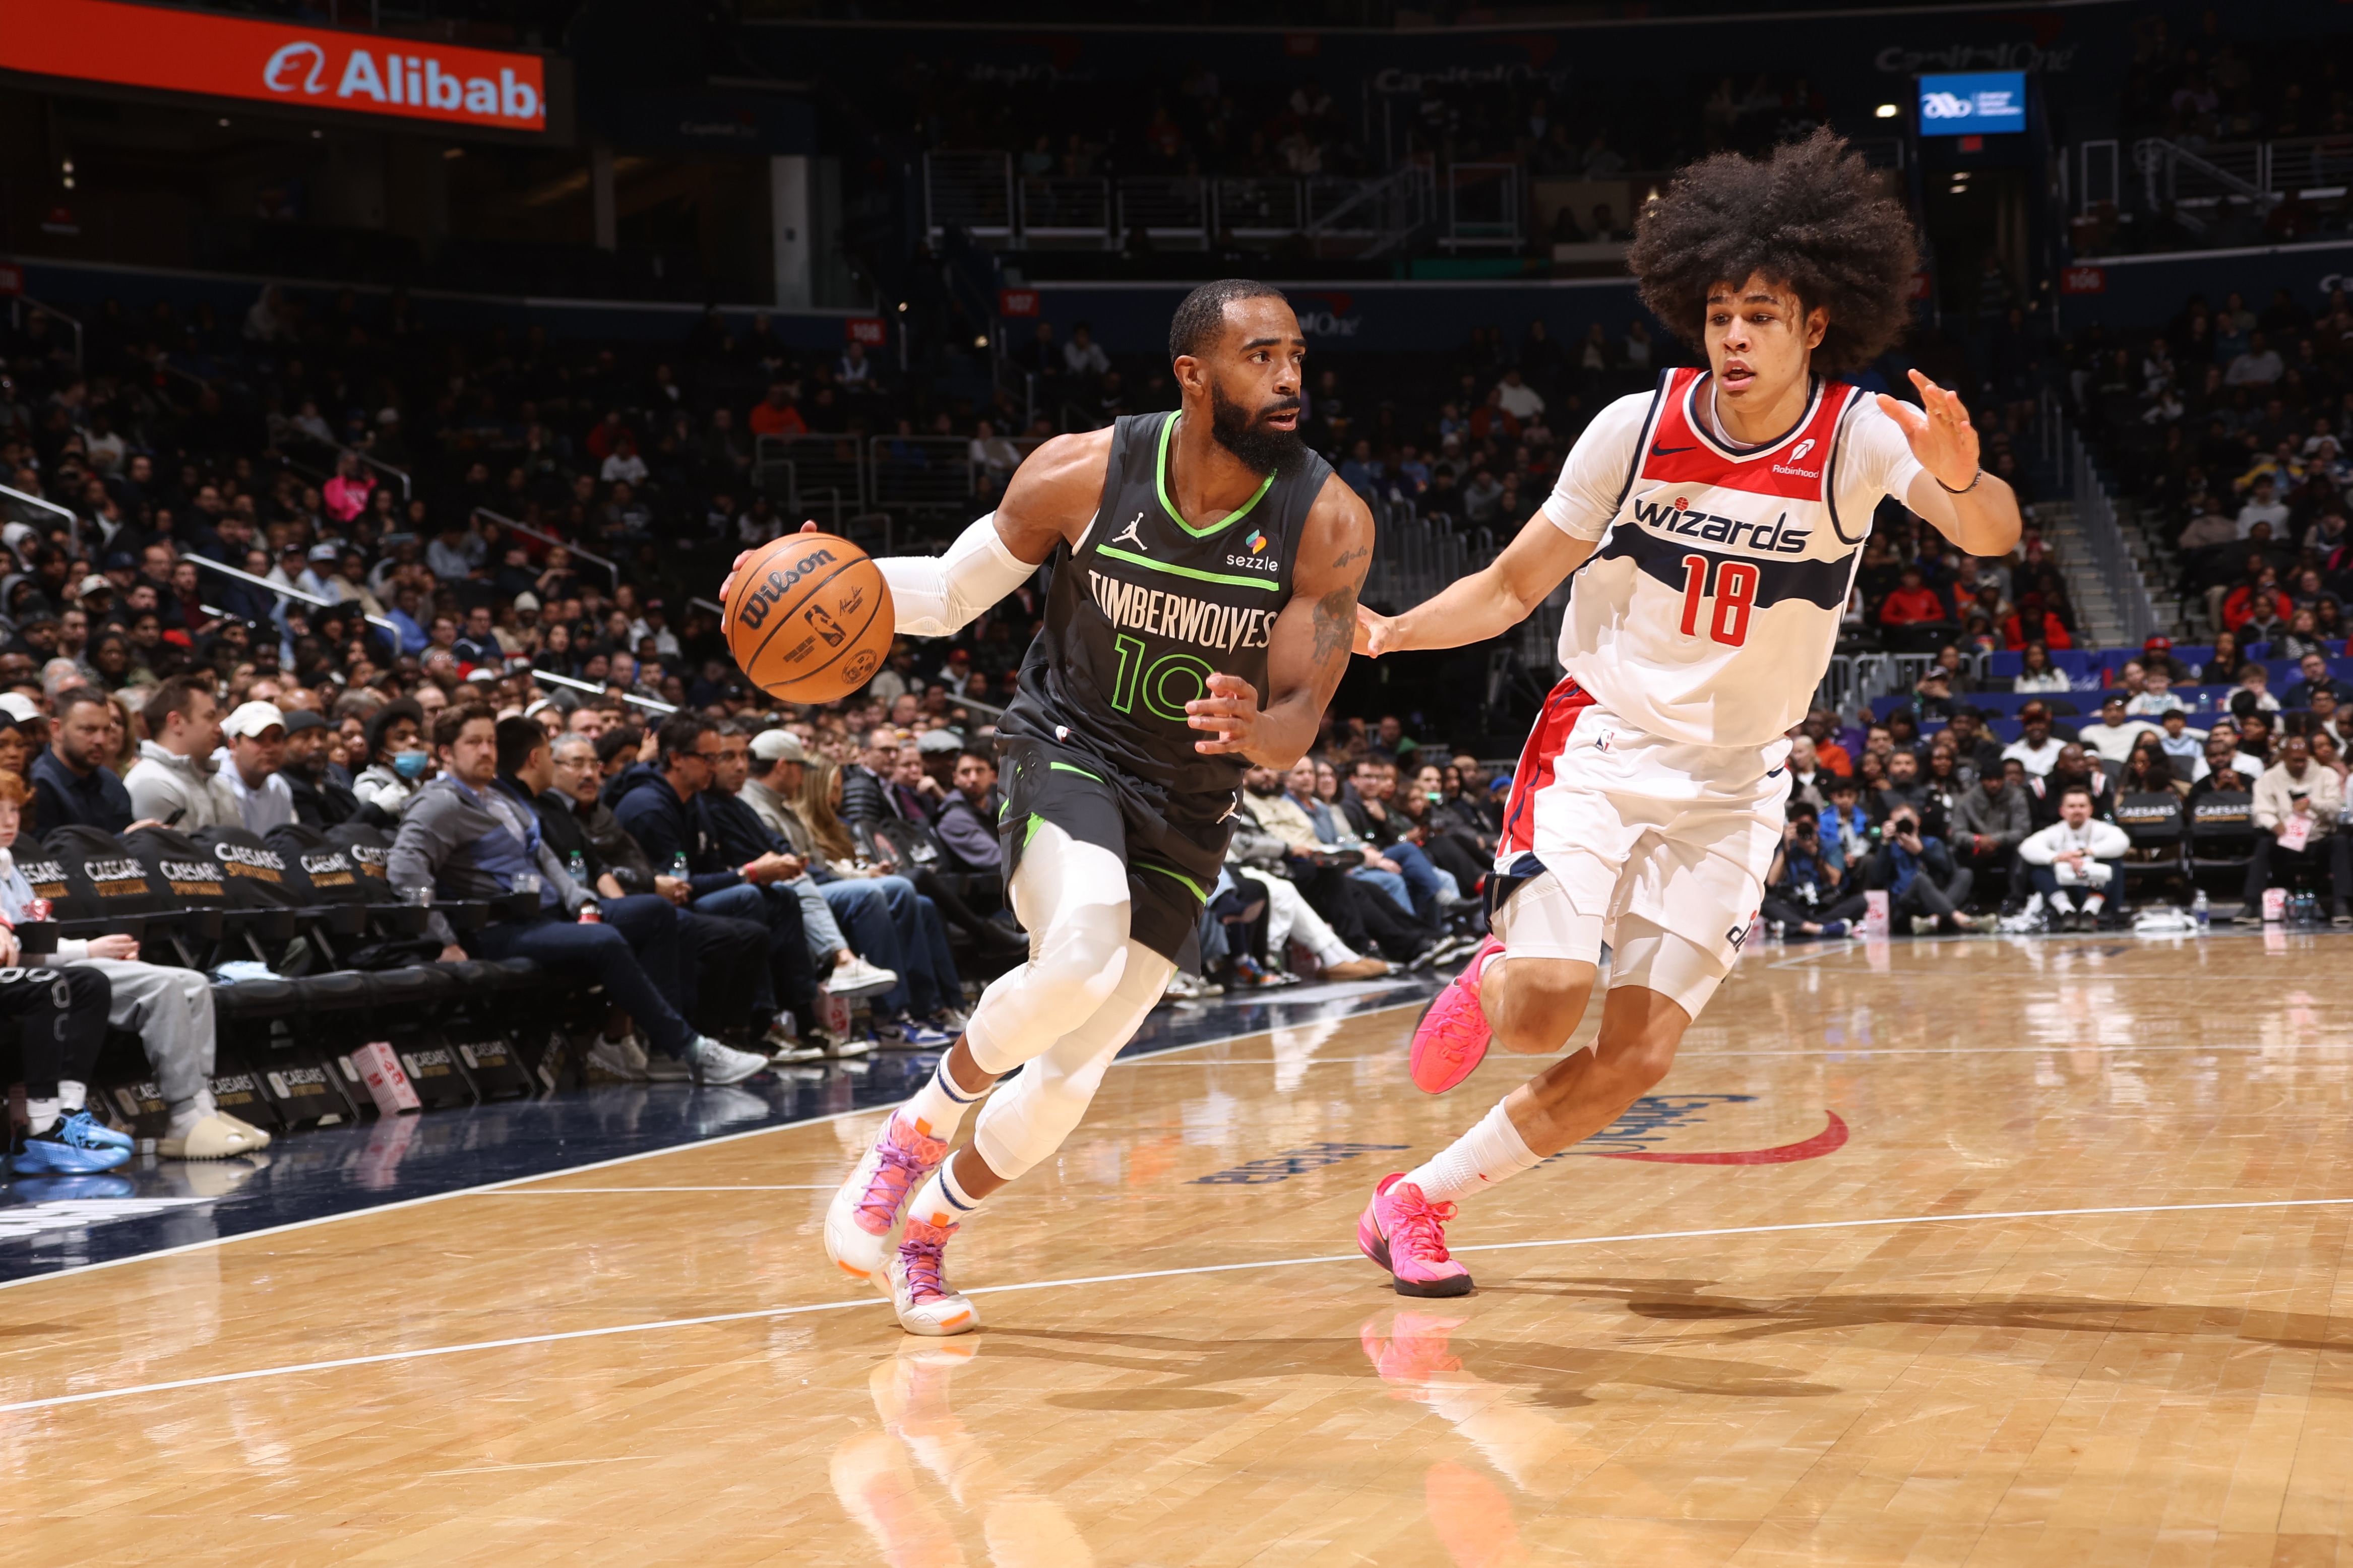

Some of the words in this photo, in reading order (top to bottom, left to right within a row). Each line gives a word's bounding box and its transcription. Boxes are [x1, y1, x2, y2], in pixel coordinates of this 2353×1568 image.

[338, 49, 545, 119] Alibab
[1772, 465, 1819, 478] Robinhood
[739, 549, 837, 630] Wilson
[1226, 554, 1278, 572] sezzle
[1680, 556, 1758, 647] 18
[1089, 570, 1278, 655] TIMBERWOLVES
[1112, 634, 1216, 721] 10
